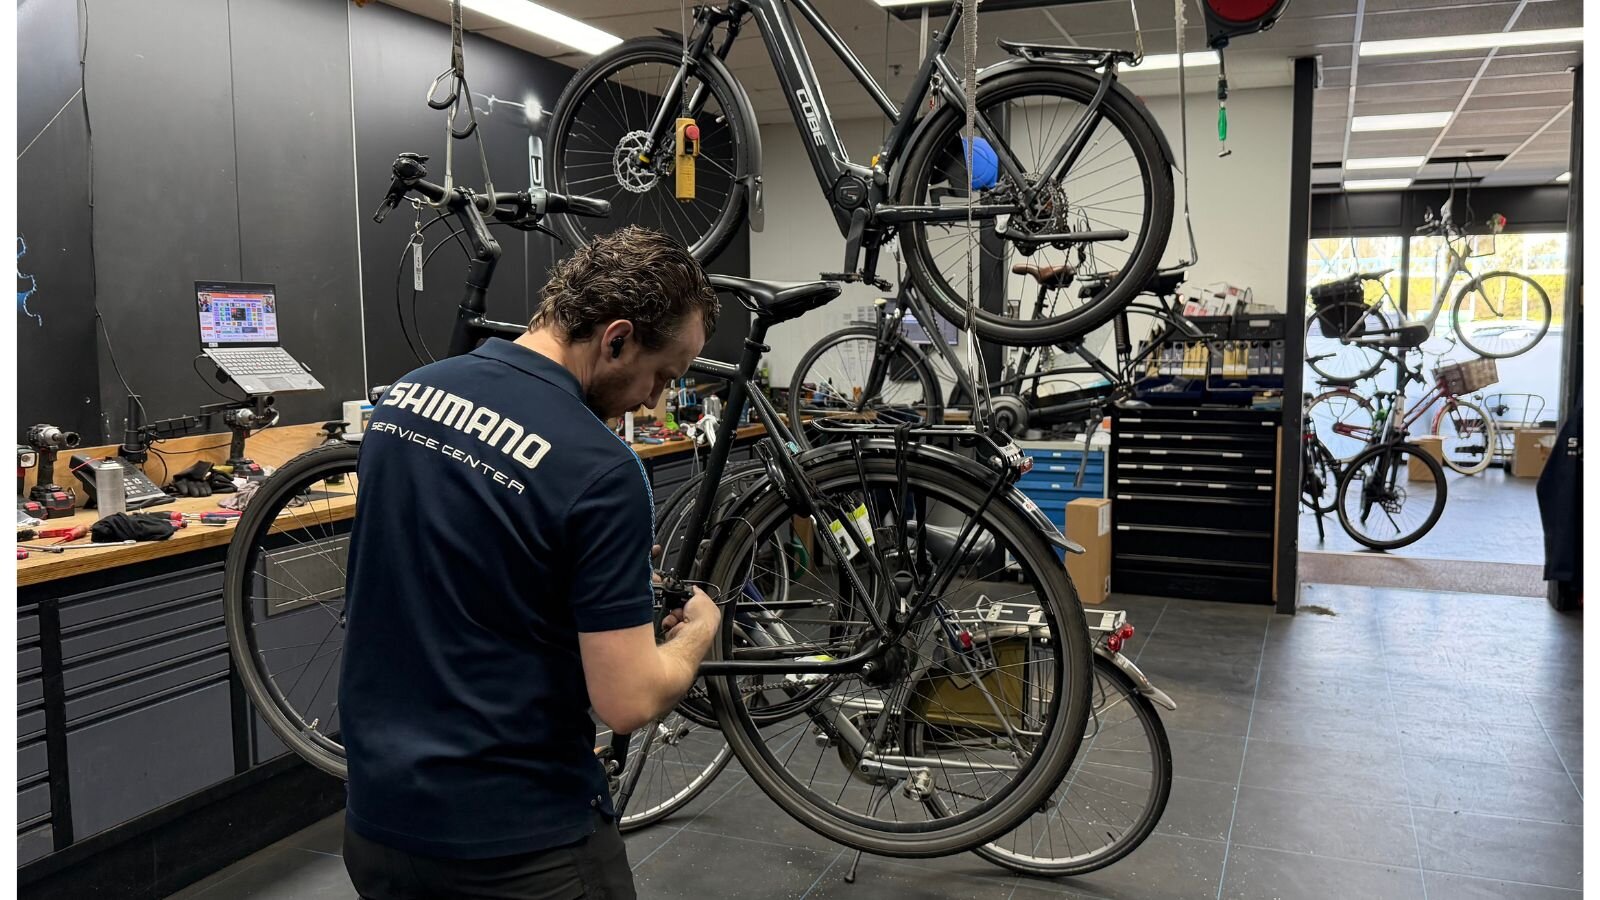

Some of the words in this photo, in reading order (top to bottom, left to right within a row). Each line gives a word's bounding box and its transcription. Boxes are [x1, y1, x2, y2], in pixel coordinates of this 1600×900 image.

[796, 88, 826, 147] CUBE
[370, 421, 440, 451] SERVICE
[441, 444, 525, 495] CENTER
[382, 382, 552, 470] SHIMANO
